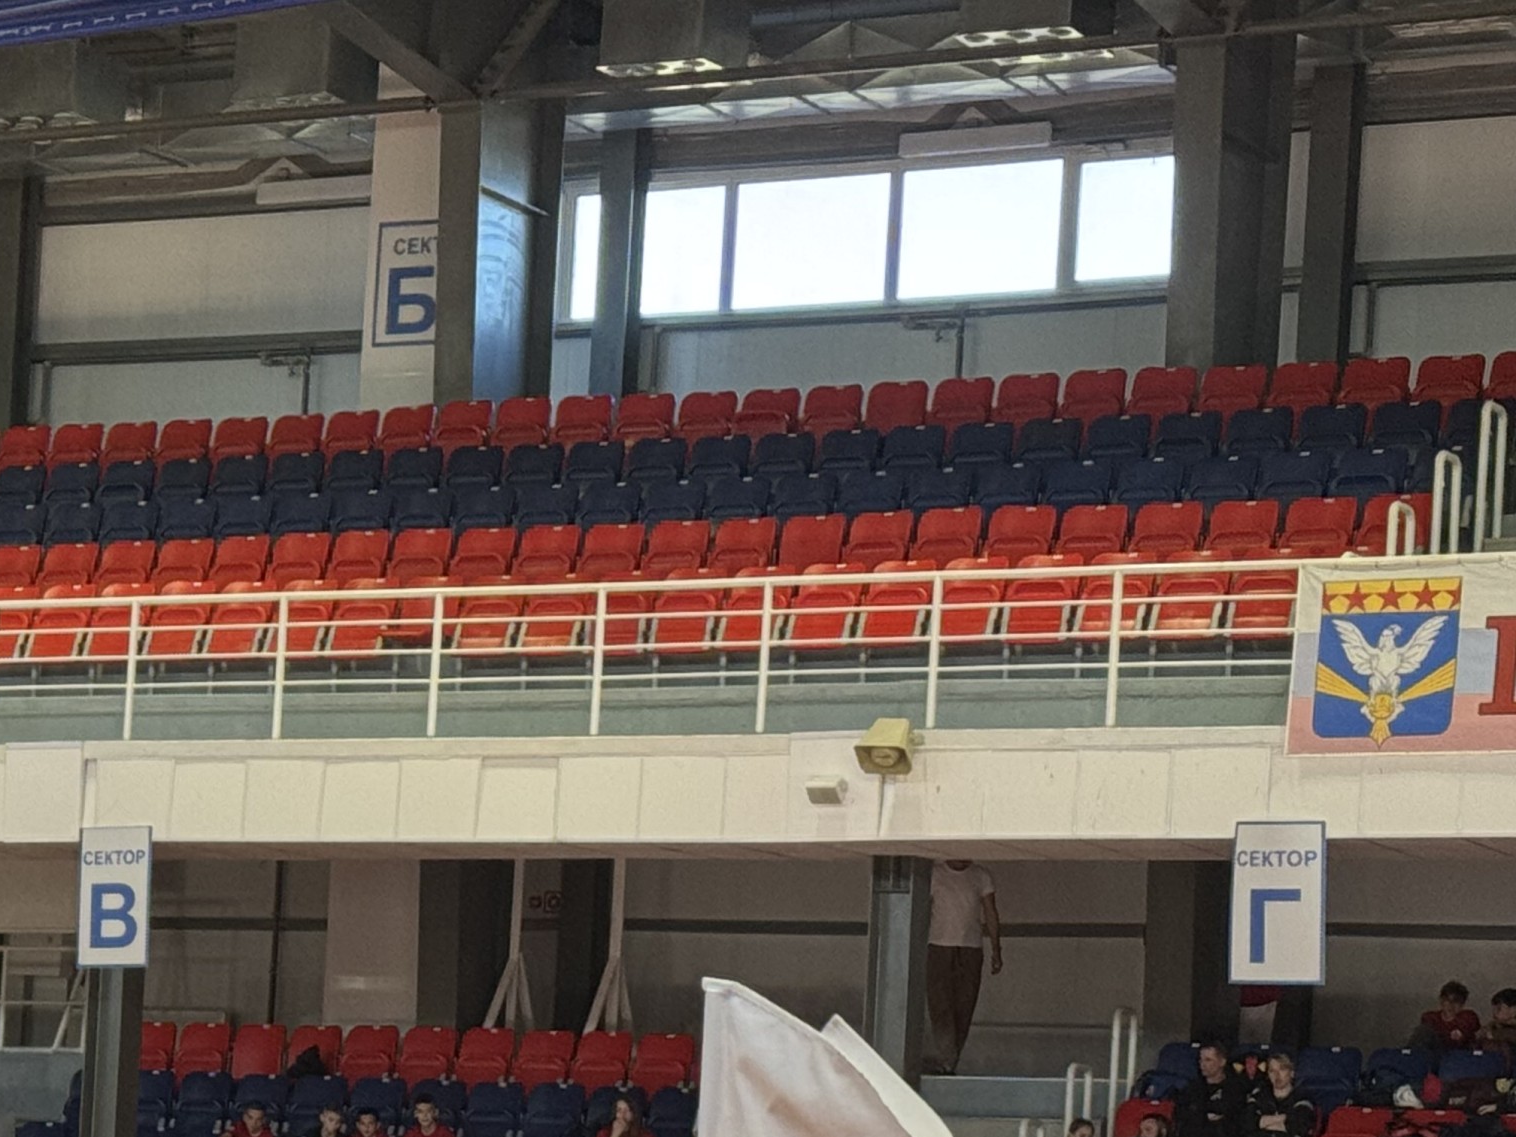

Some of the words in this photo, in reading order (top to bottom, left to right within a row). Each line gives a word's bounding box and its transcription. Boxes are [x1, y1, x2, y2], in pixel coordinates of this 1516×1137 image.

[393, 236, 438, 255] СЕК
[385, 266, 437, 335] Б
[83, 850, 146, 865] СЕКТОР
[1236, 850, 1318, 868] СЕКТОР
[89, 882, 137, 949] В
[1250, 889, 1301, 963] Г
